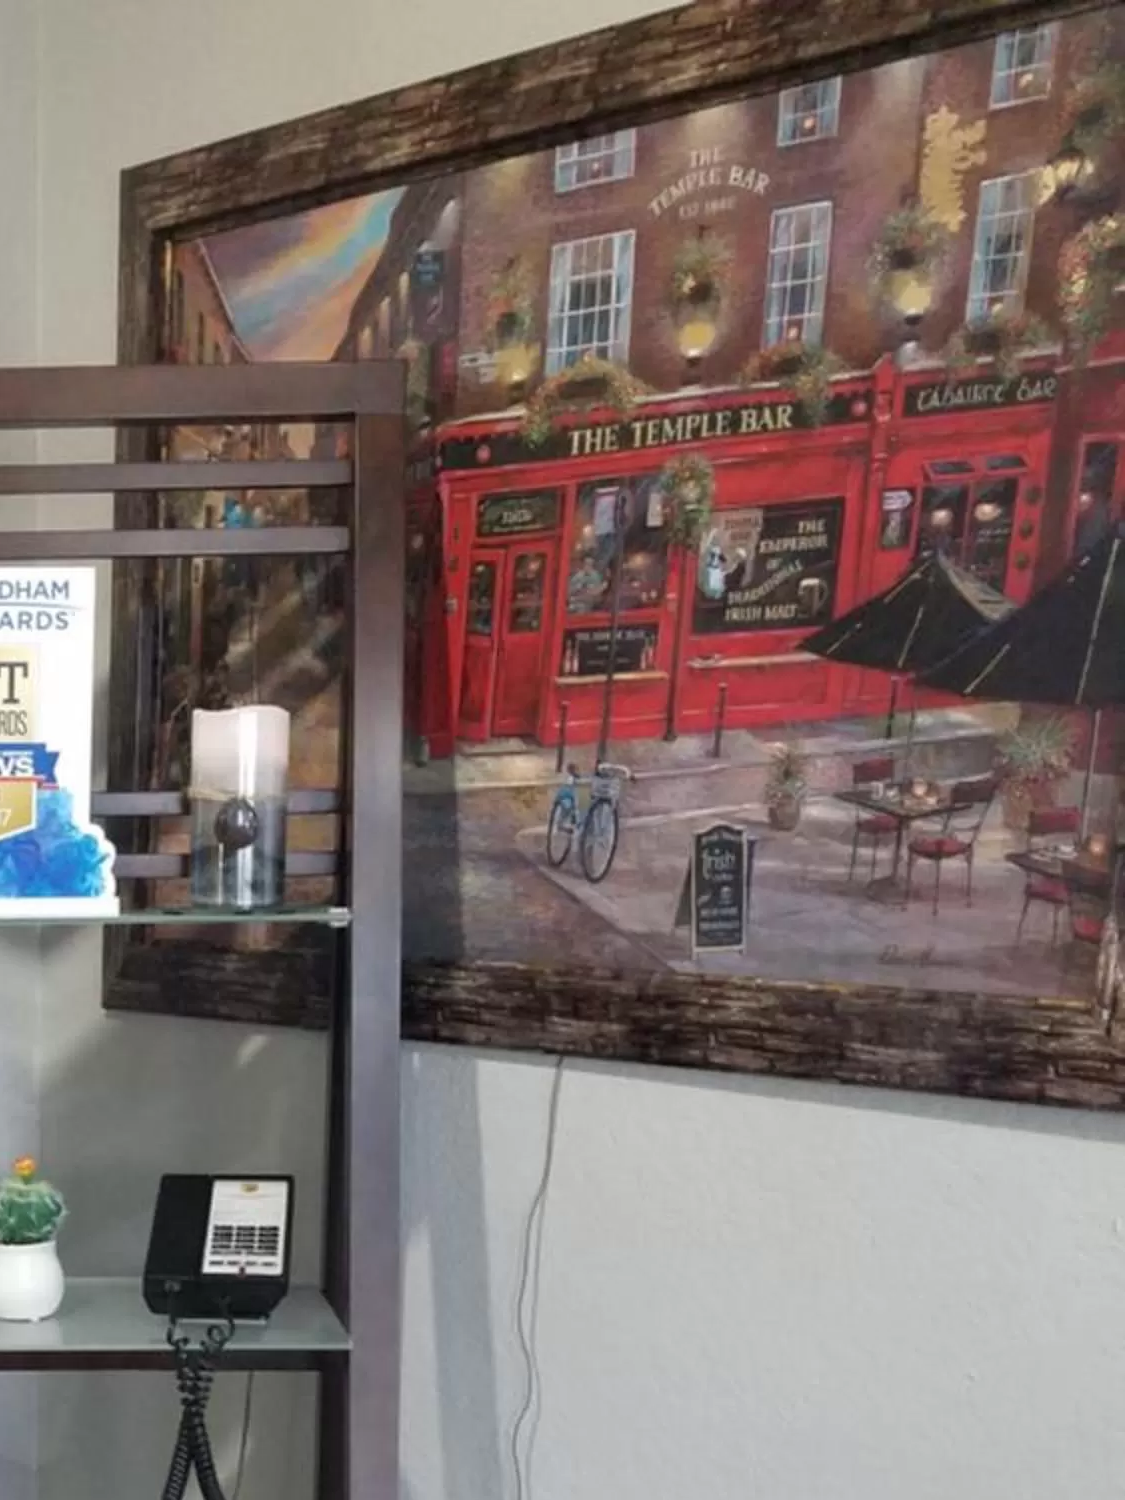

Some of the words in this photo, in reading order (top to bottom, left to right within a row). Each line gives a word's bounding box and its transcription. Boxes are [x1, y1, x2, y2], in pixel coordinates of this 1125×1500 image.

[728, 164, 771, 196] BAR
[569, 423, 620, 457] THE
[631, 410, 732, 448] TEMPLE
[739, 404, 794, 433] BAR
